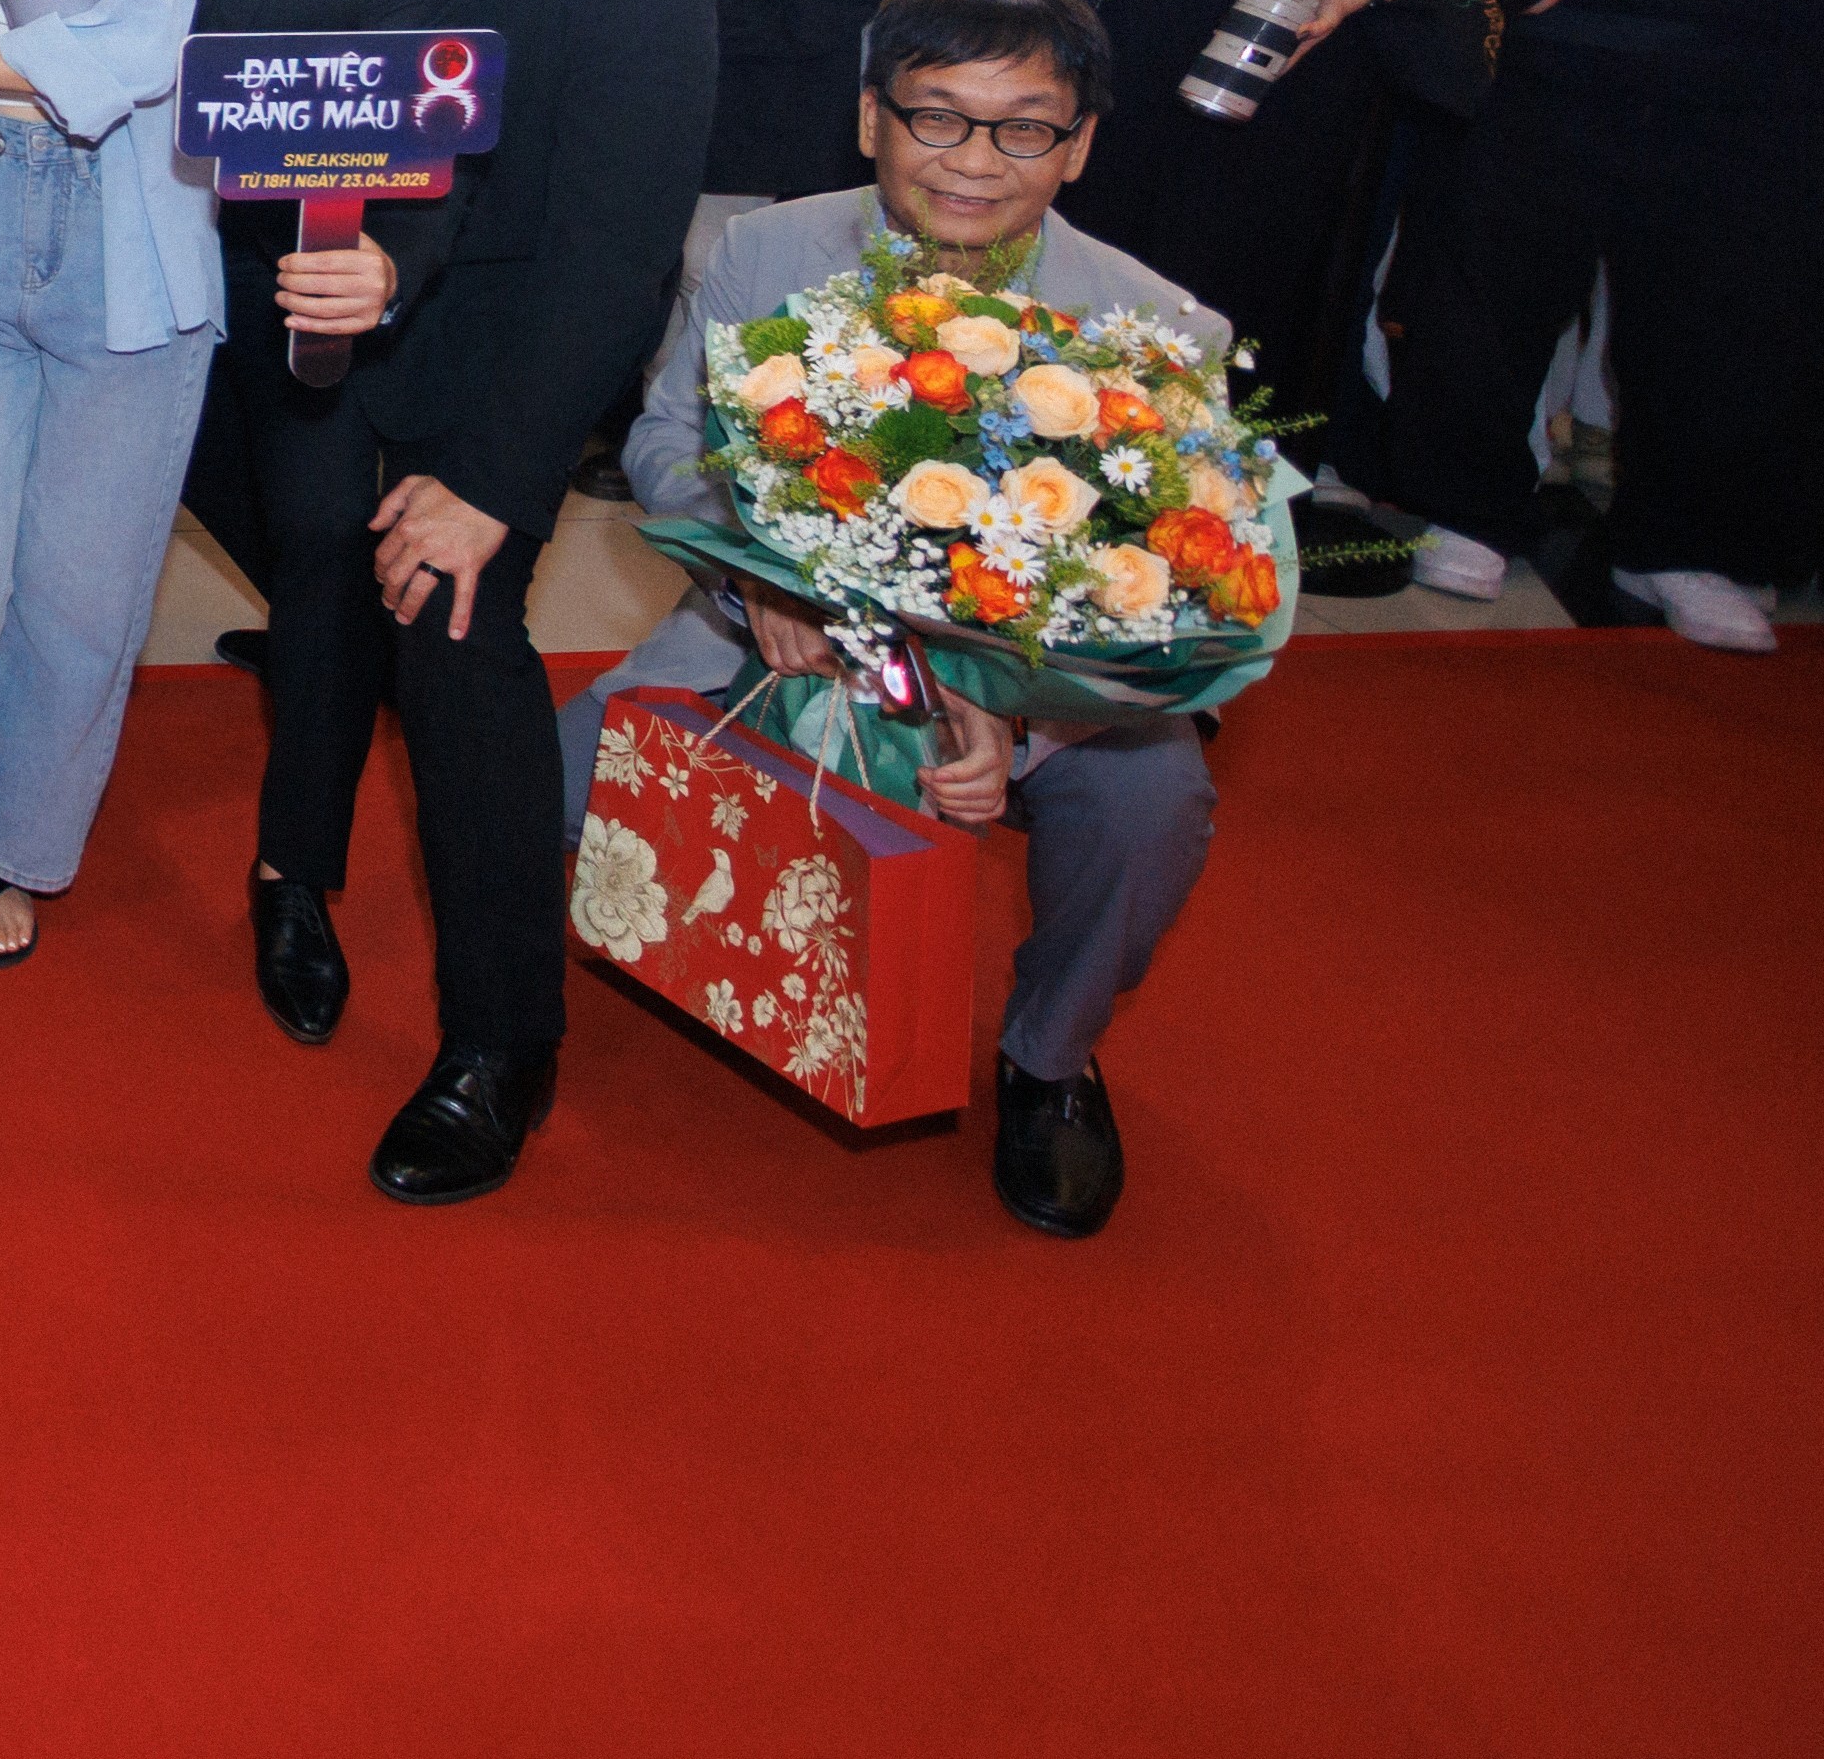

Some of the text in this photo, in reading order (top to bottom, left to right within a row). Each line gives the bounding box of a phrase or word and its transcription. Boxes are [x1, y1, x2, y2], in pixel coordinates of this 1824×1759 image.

[236, 51, 383, 93] ĐẠI TIỆC
[198, 91, 310, 140] TRĂNG
[322, 94, 400, 130] MÁU
[283, 153, 388, 168] SNEAKSHOW
[239, 172, 431, 188] TỪ 18H NGÀY 23.04.2026
